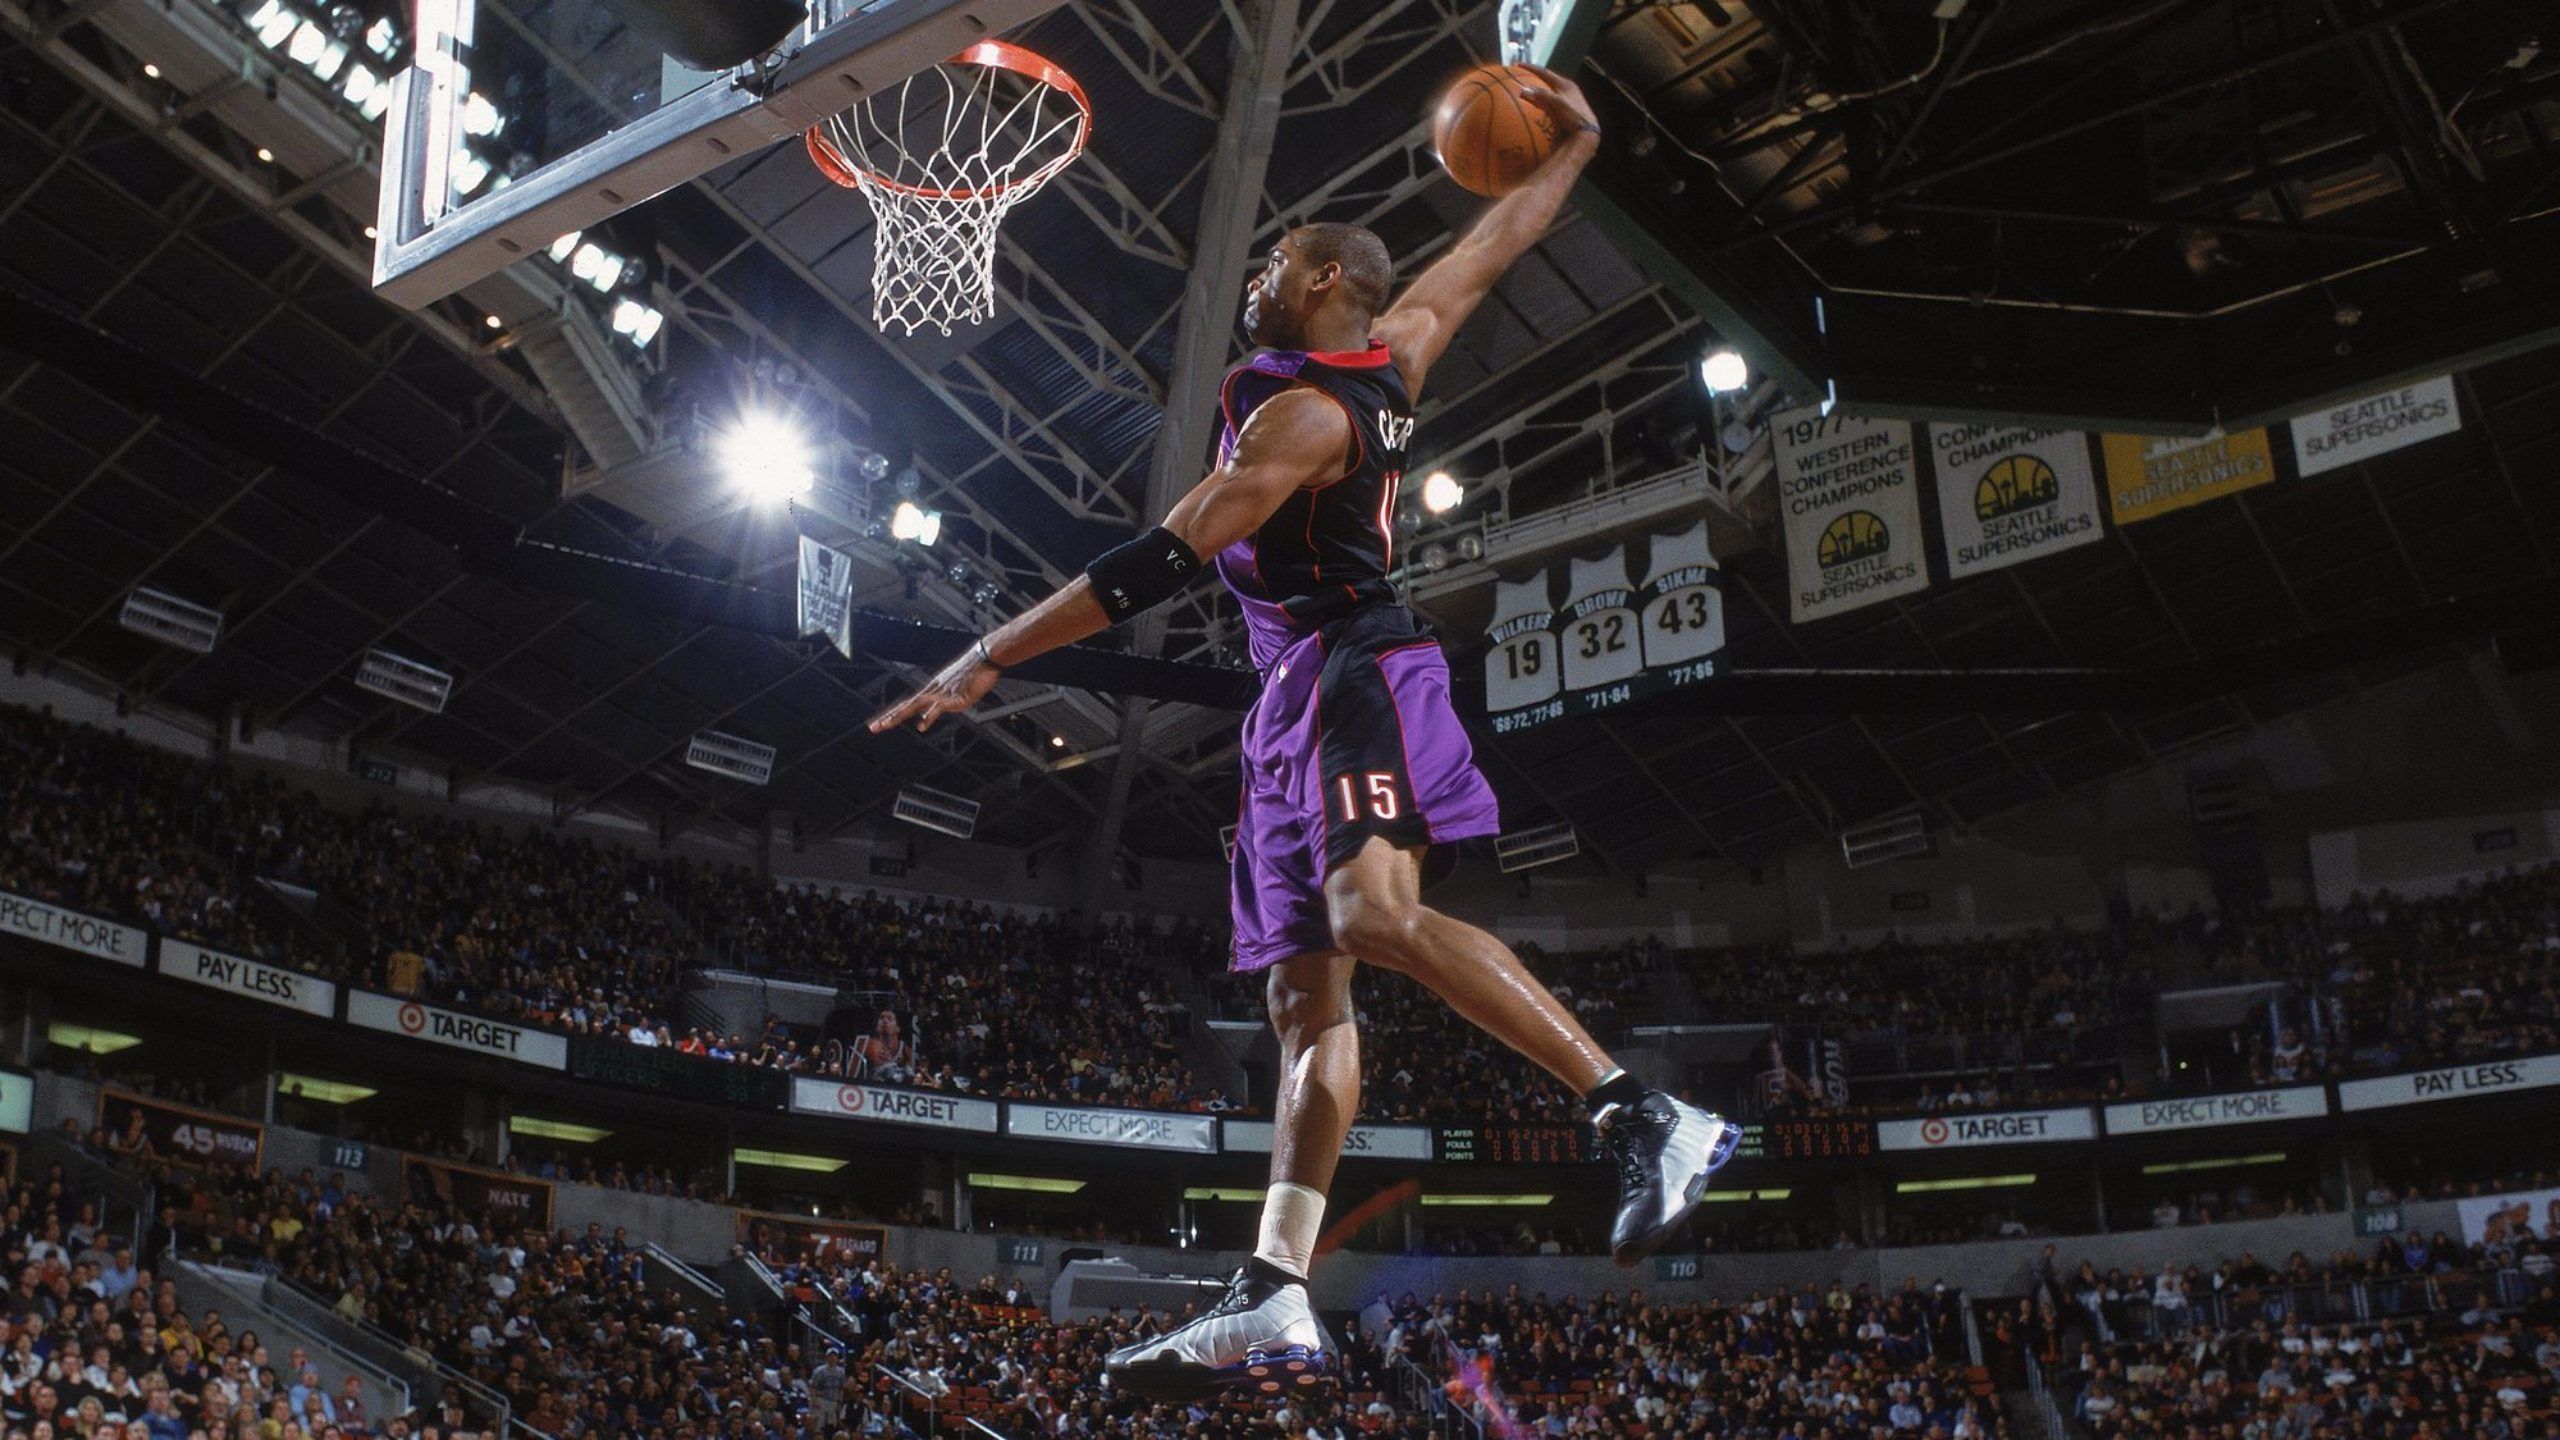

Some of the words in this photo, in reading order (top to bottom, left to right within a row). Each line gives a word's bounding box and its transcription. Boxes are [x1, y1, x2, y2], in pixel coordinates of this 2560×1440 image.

[2330, 389, 2415, 430] SEATTLE
[2305, 399, 2448, 456] SUPERSONICS
[1797, 431, 1890, 473] WESTERN
[1782, 443, 1910, 497] CONFERENCE
[1791, 468, 1904, 515] CHAMPIONS
[1983, 504, 2060, 540] SEATTLE
[1957, 513, 2093, 566] SUPERSONICS
[1823, 553, 1890, 584] SEATTLE
[1801, 561, 1917, 608] SUPERSONICS
[1658, 592, 1707, 634] 43
[1578, 615, 1626, 658] 32
[1505, 640, 1541, 679] 19
[1336, 772, 1399, 822] 15
[198, 953, 236, 984] PAY
[430, 1012, 521, 1053] TARGET
[2413, 1072, 2456, 1096] PAY
[868, 1090, 960, 1121] TARGET
[2142, 1099, 2219, 1126] EXPECT
[1044, 1110, 1114, 1136] EXPECT
[1953, 1114, 2049, 1140] TARGET
[172, 1124, 215, 1155] 45
[1343, 1130, 1372, 1151] SS.
[334, 1146, 364, 1168] 113
[488, 1189, 531, 1208] NATE
[1012, 1244, 1038, 1262] 111
[1670, 1261, 1697, 1278] 110
[1236, 1293, 1249, 1305] 15
